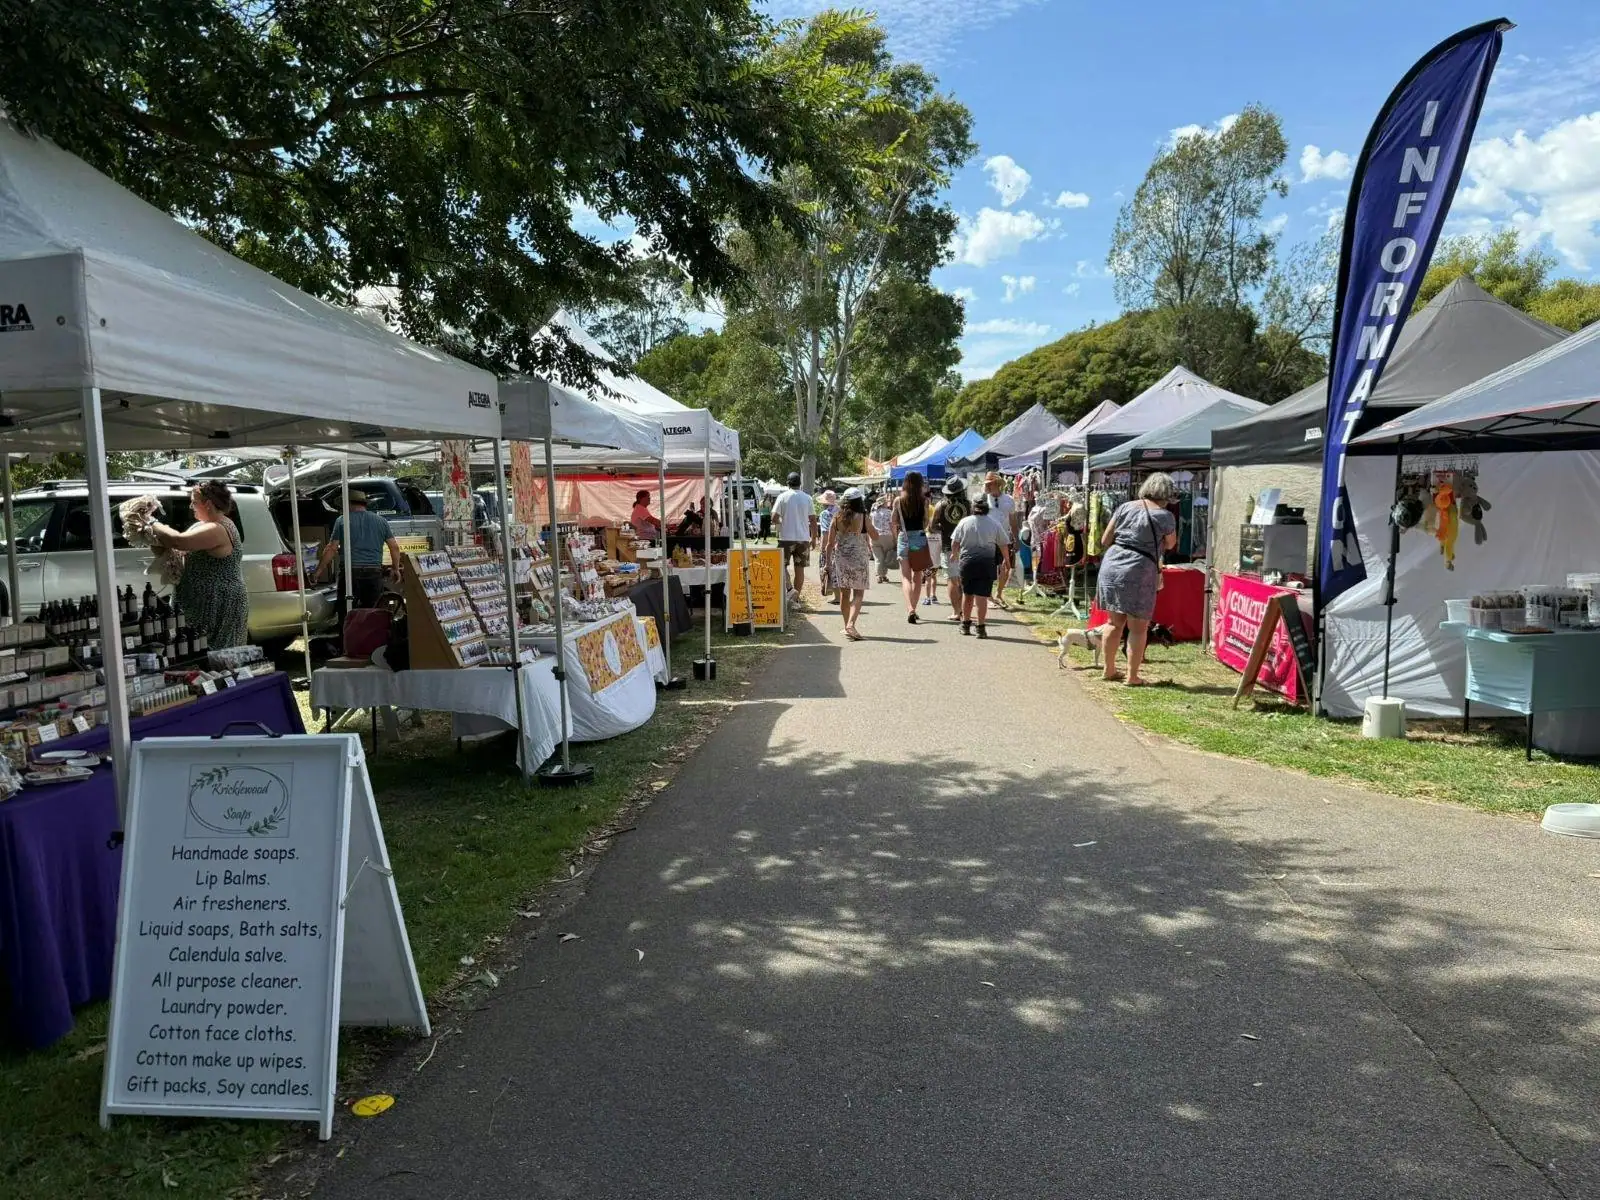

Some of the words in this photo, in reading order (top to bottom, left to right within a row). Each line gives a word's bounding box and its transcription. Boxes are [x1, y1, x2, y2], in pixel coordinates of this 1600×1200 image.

[1330, 100, 1440, 572] INFORMATION
[212, 780, 271, 796] Kricklewood
[223, 807, 252, 826] Soaps
[171, 844, 249, 861] Handmade
[253, 847, 300, 864] soaps.
[195, 870, 218, 890] Lip
[223, 869, 270, 886] Balms.
[173, 896, 197, 911] Air
[202, 895, 291, 911] fresheners.
[139, 920, 183, 940] Liquid
[187, 923, 234, 940] soaps,
[239, 920, 275, 937] Bath
[279, 920, 322, 940] salts,
[168, 946, 240, 963] Calendula
[244, 946, 287, 963] salve.
[151, 971, 172, 988] All
[176, 975, 237, 992] purpose
[241, 972, 302, 989] cleaner.
[161, 997, 222, 1019] Laundry
[227, 998, 288, 1019] powder.
[149, 1024, 200, 1040] Cotton
[205, 1024, 240, 1041] face
[244, 1025, 297, 1042] cloths.
[136, 1050, 187, 1066] Cotton
[192, 1051, 232, 1068] make
[236, 1056, 255, 1072] up
[259, 1053, 307, 1073] wipes.
[127, 1075, 159, 1092] Gift
[163, 1076, 212, 1097] packs,
[216, 1078, 245, 1099] Soy
[250, 1079, 313, 1096] candles.
